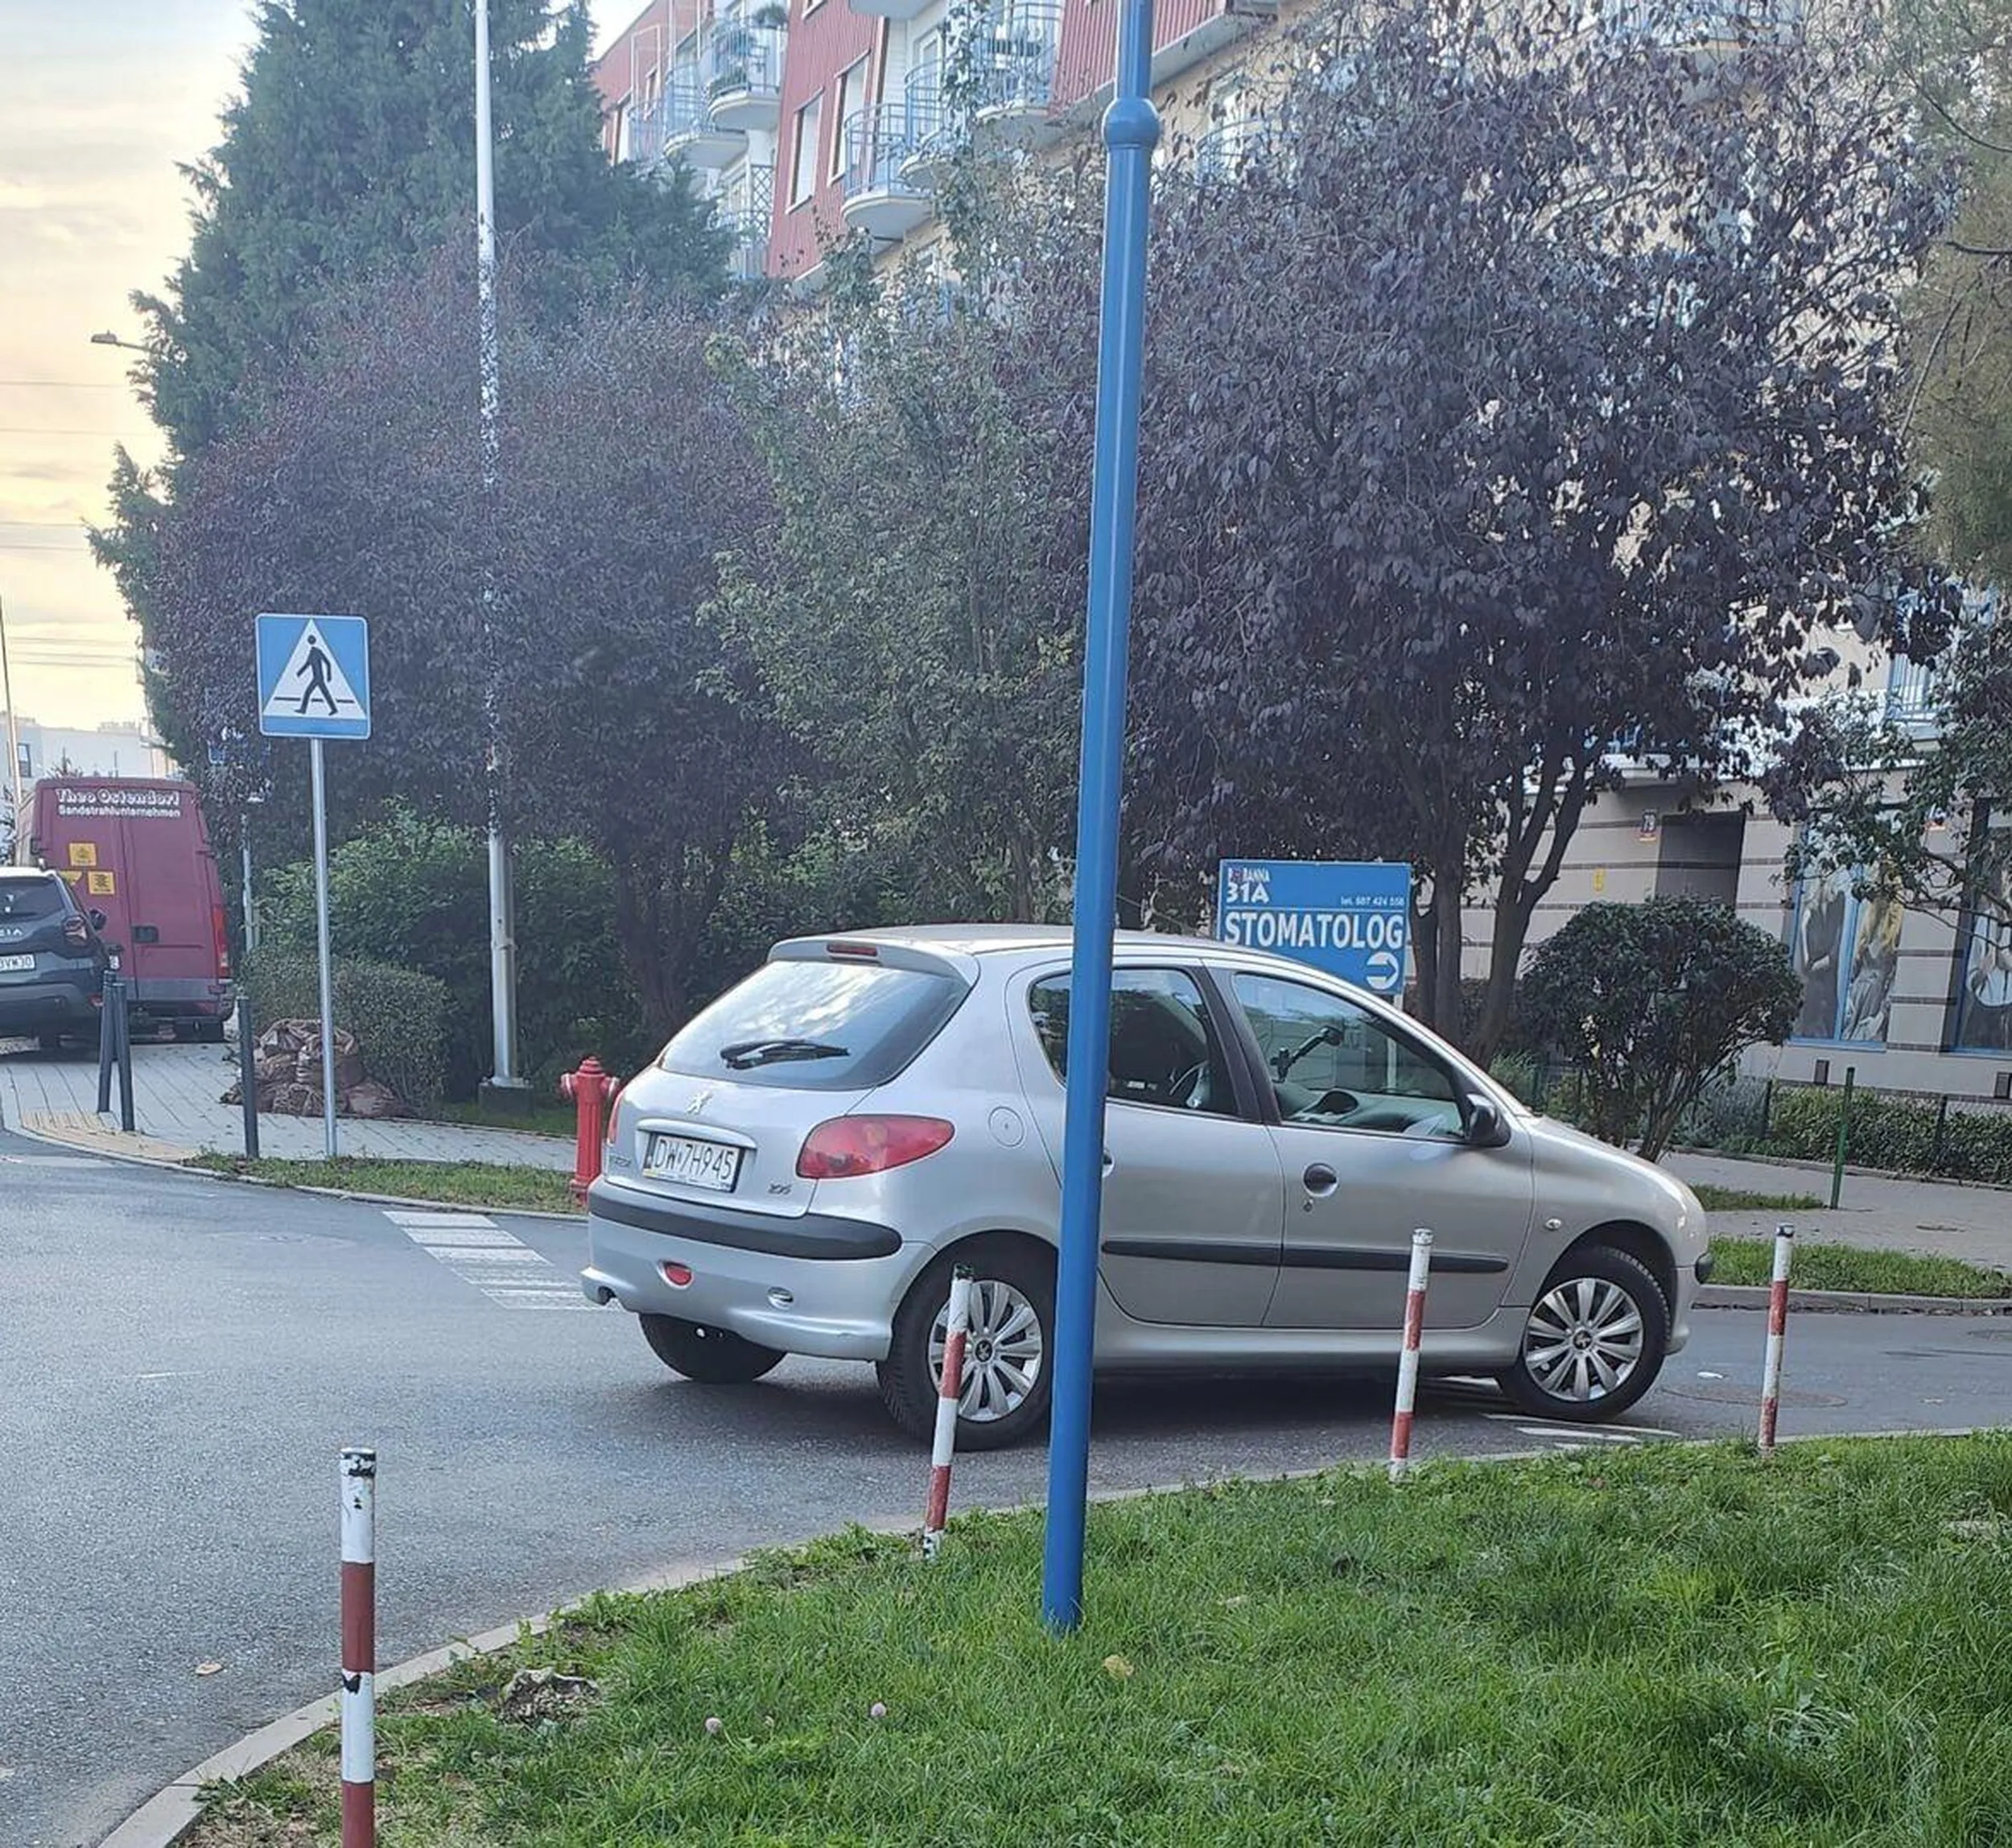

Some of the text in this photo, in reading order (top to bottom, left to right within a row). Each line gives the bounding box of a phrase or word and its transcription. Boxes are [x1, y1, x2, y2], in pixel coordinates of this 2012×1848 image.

[56, 788, 96, 804] Theo
[1227, 882, 1270, 903] 31A
[1224, 912, 1404, 951] STOMATOLOG
[654, 1138, 735, 1181] DW 7H945
